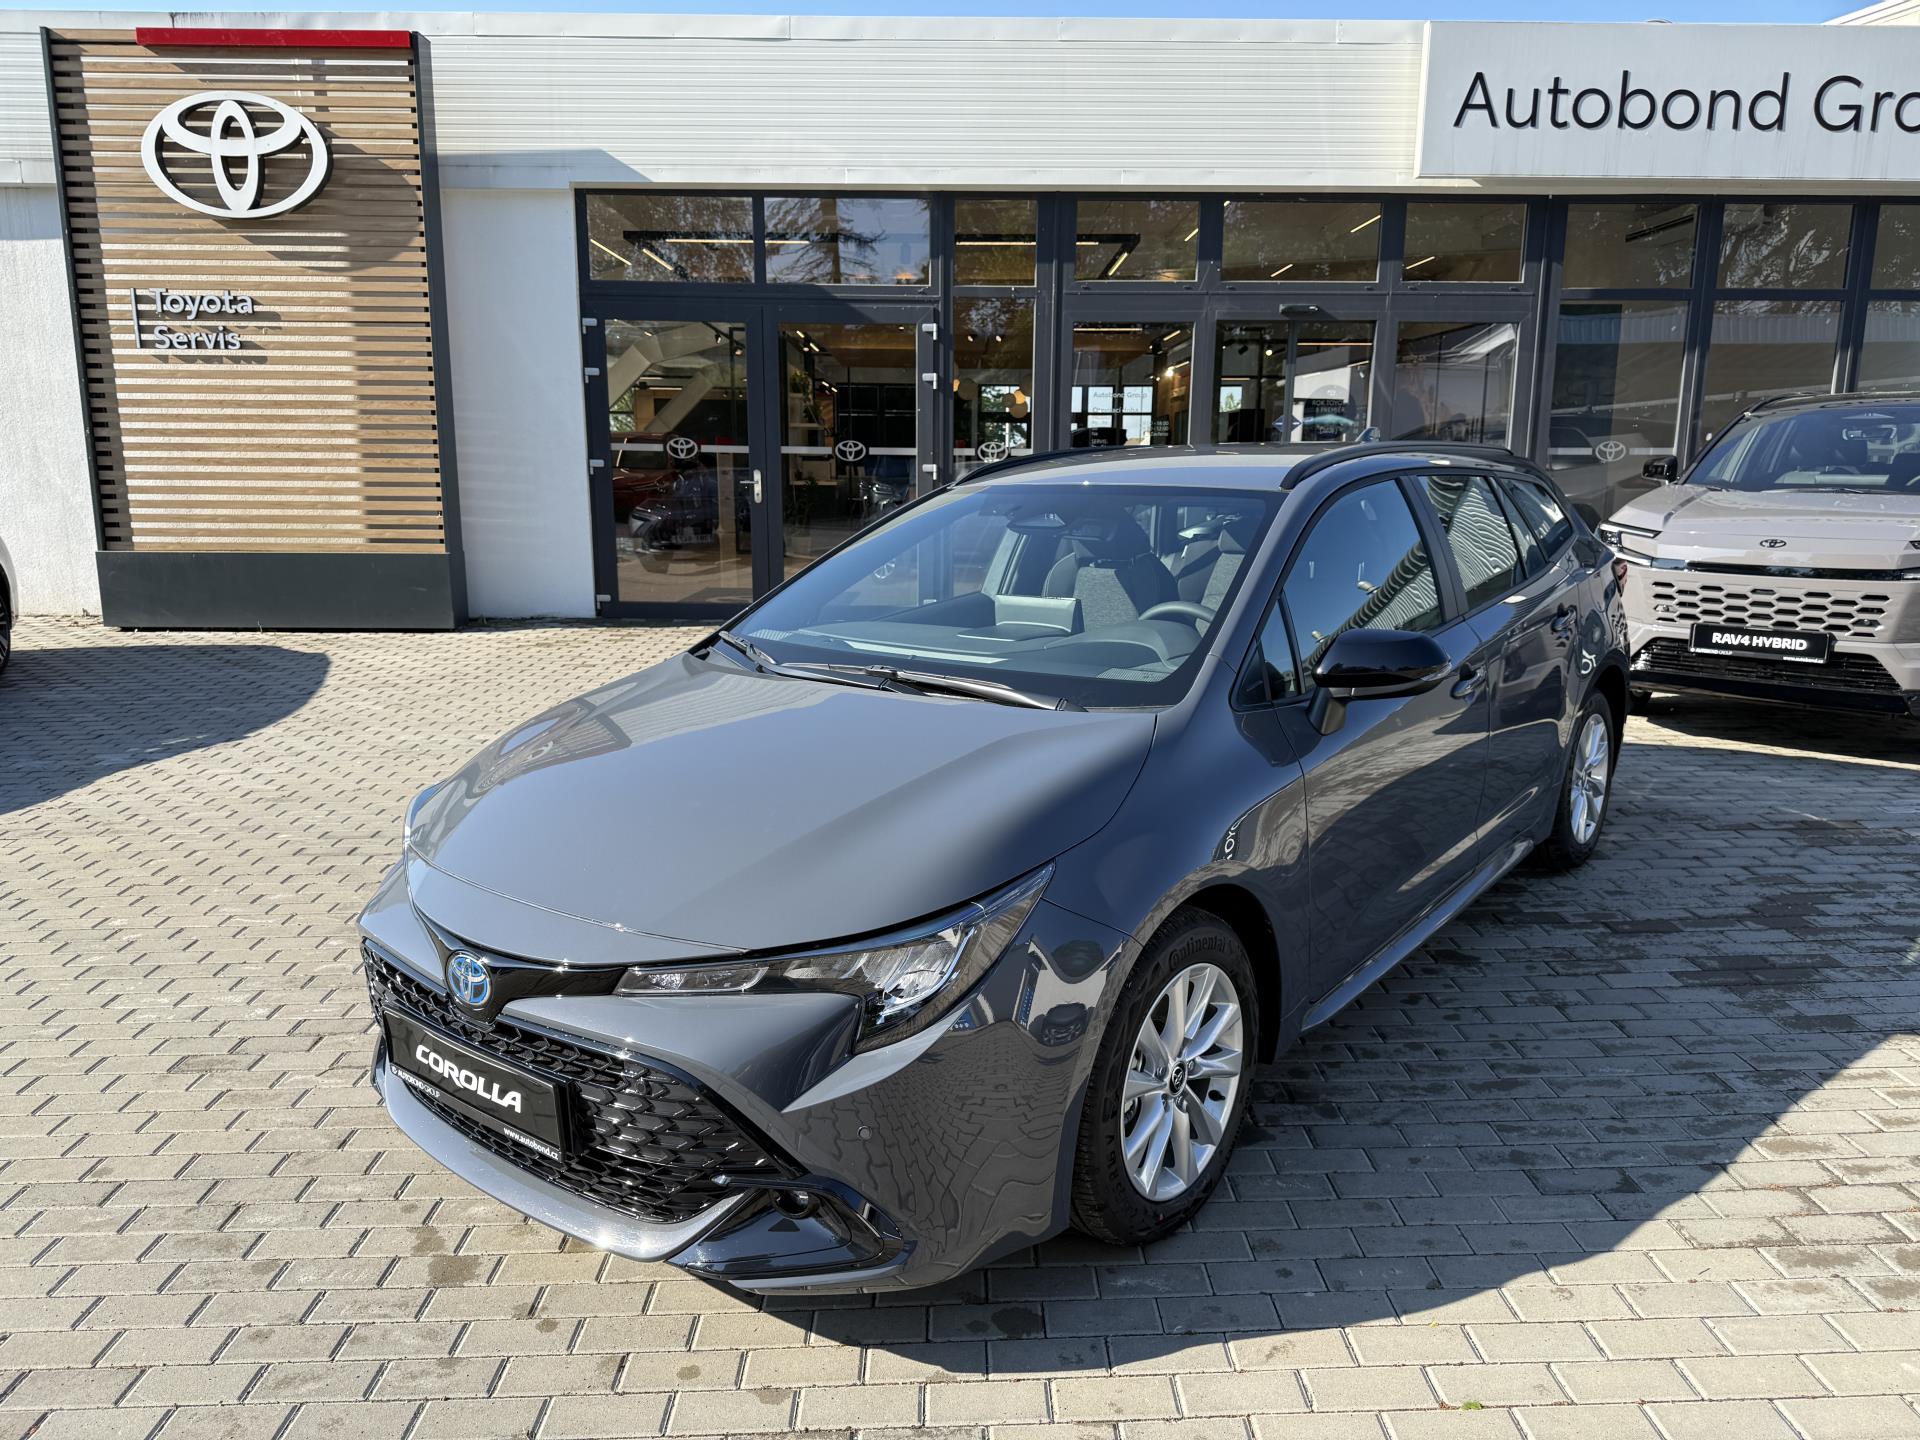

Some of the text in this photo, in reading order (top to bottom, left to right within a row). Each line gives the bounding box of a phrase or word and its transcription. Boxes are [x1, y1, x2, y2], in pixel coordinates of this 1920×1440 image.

[1453, 70, 1792, 131] Autobond
[149, 288, 254, 320] Toyota
[153, 325, 241, 349] Servis
[1711, 632, 1808, 651] RAV4 HYBRID
[1168, 935, 1226, 971] Continental
[415, 1044, 522, 1113] COROLLA
[503, 1127, 559, 1160] www.autobond.cz
